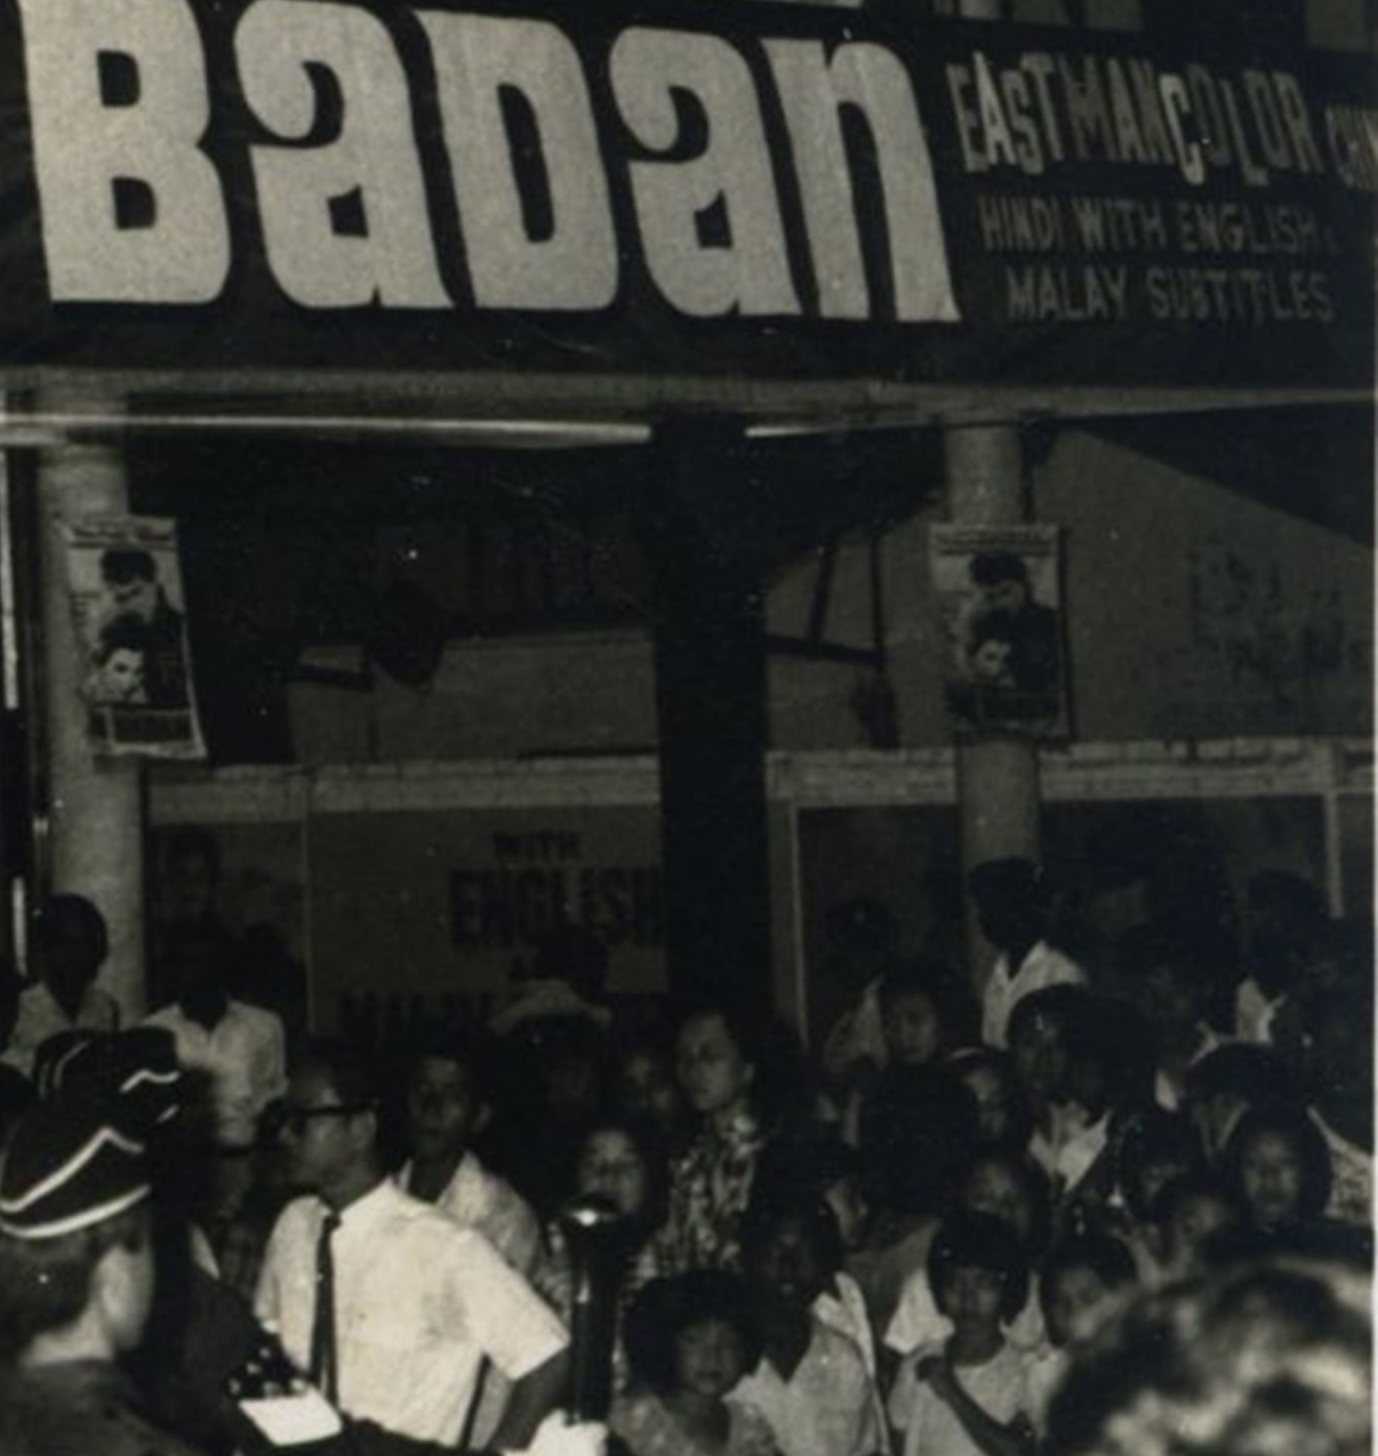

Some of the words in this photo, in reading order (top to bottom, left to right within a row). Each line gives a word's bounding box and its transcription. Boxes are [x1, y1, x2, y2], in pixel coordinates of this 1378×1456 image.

[945, 49, 1327, 186] EASTMANCOLOR
[978, 196, 1062, 252] HINDI
[1072, 196, 1168, 252] WITH
[1176, 200, 1319, 256] ENGLISH
[1005, 264, 1127, 321] MALAY
[1146, 268, 1336, 325] SUBTITLES
